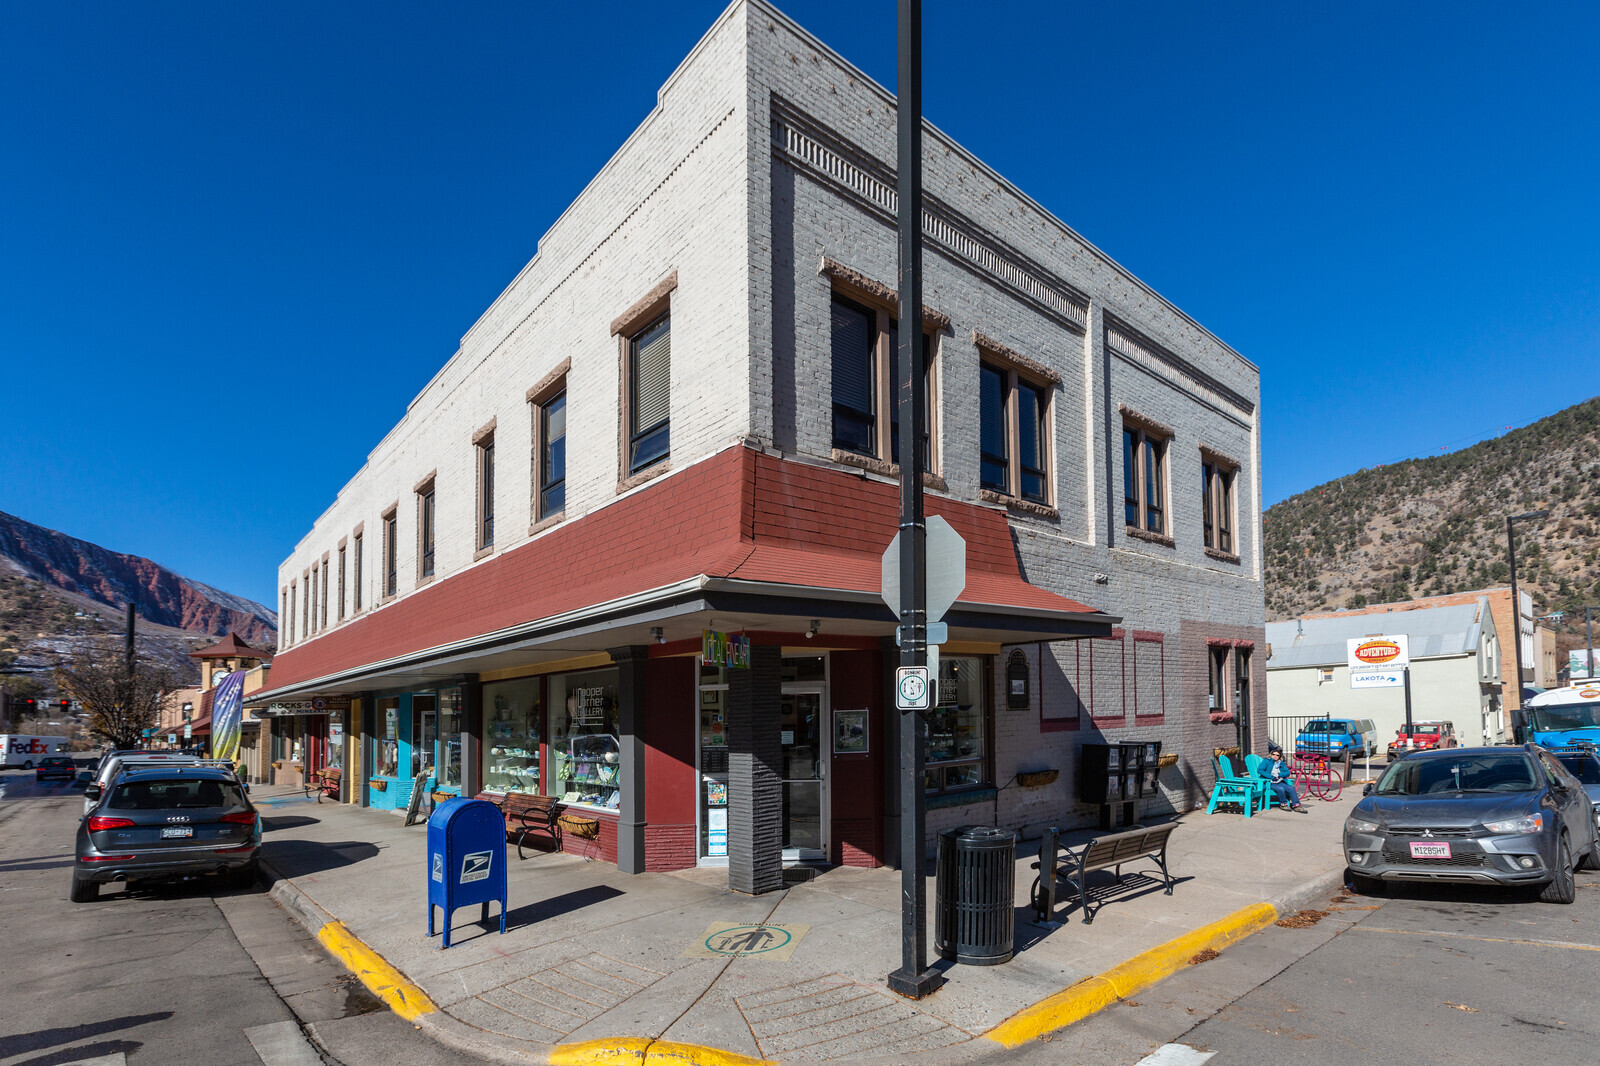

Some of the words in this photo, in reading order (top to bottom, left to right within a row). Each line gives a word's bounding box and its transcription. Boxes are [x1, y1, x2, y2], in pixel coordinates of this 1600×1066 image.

[703, 638, 725, 664] LOCAL
[1360, 647, 1396, 656] ADVENTURE
[577, 707, 604, 717] GALLERY
[9, 737, 49, 755] FedEx
